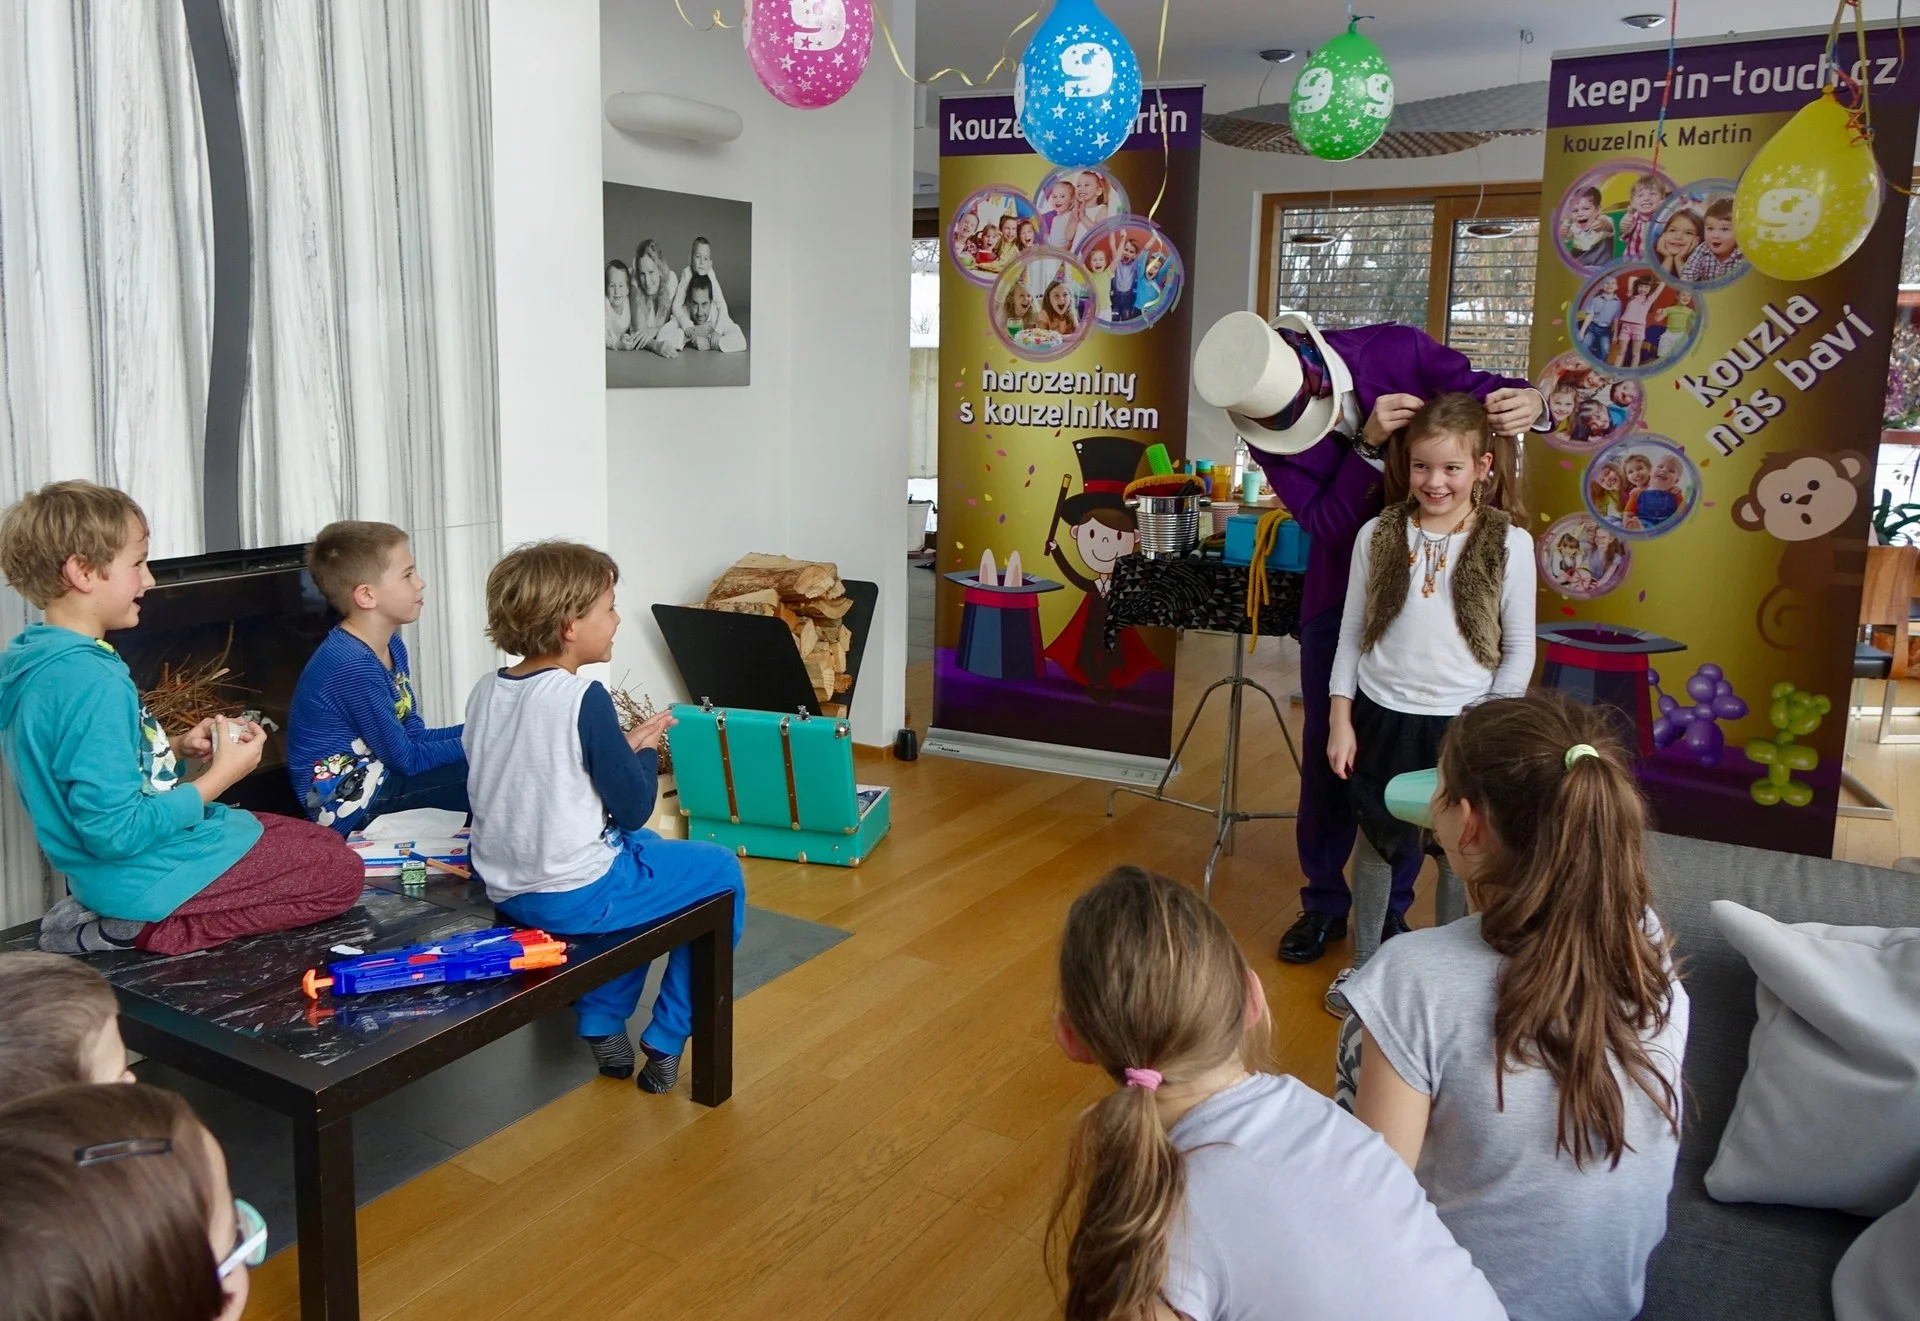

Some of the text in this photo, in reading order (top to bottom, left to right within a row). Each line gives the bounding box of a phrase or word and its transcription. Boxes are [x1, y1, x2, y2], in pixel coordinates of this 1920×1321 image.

[791, 0, 846, 51] 9
[1061, 42, 1113, 97] 9
[1296, 67, 1334, 114] 9
[1567, 53, 1899, 113] keep-in-touch.cz
[1363, 73, 1395, 119] 9
[949, 103, 1188, 141] kouze rtin
[1563, 123, 1752, 154] kouzelník Martin
[1757, 188, 1821, 242] 9
[1680, 294, 1820, 408] kouzla
[982, 364, 1137, 402] narozeniny
[1704, 303, 1876, 457] nás baví
[959, 396, 1160, 430] s kouzelníkem
